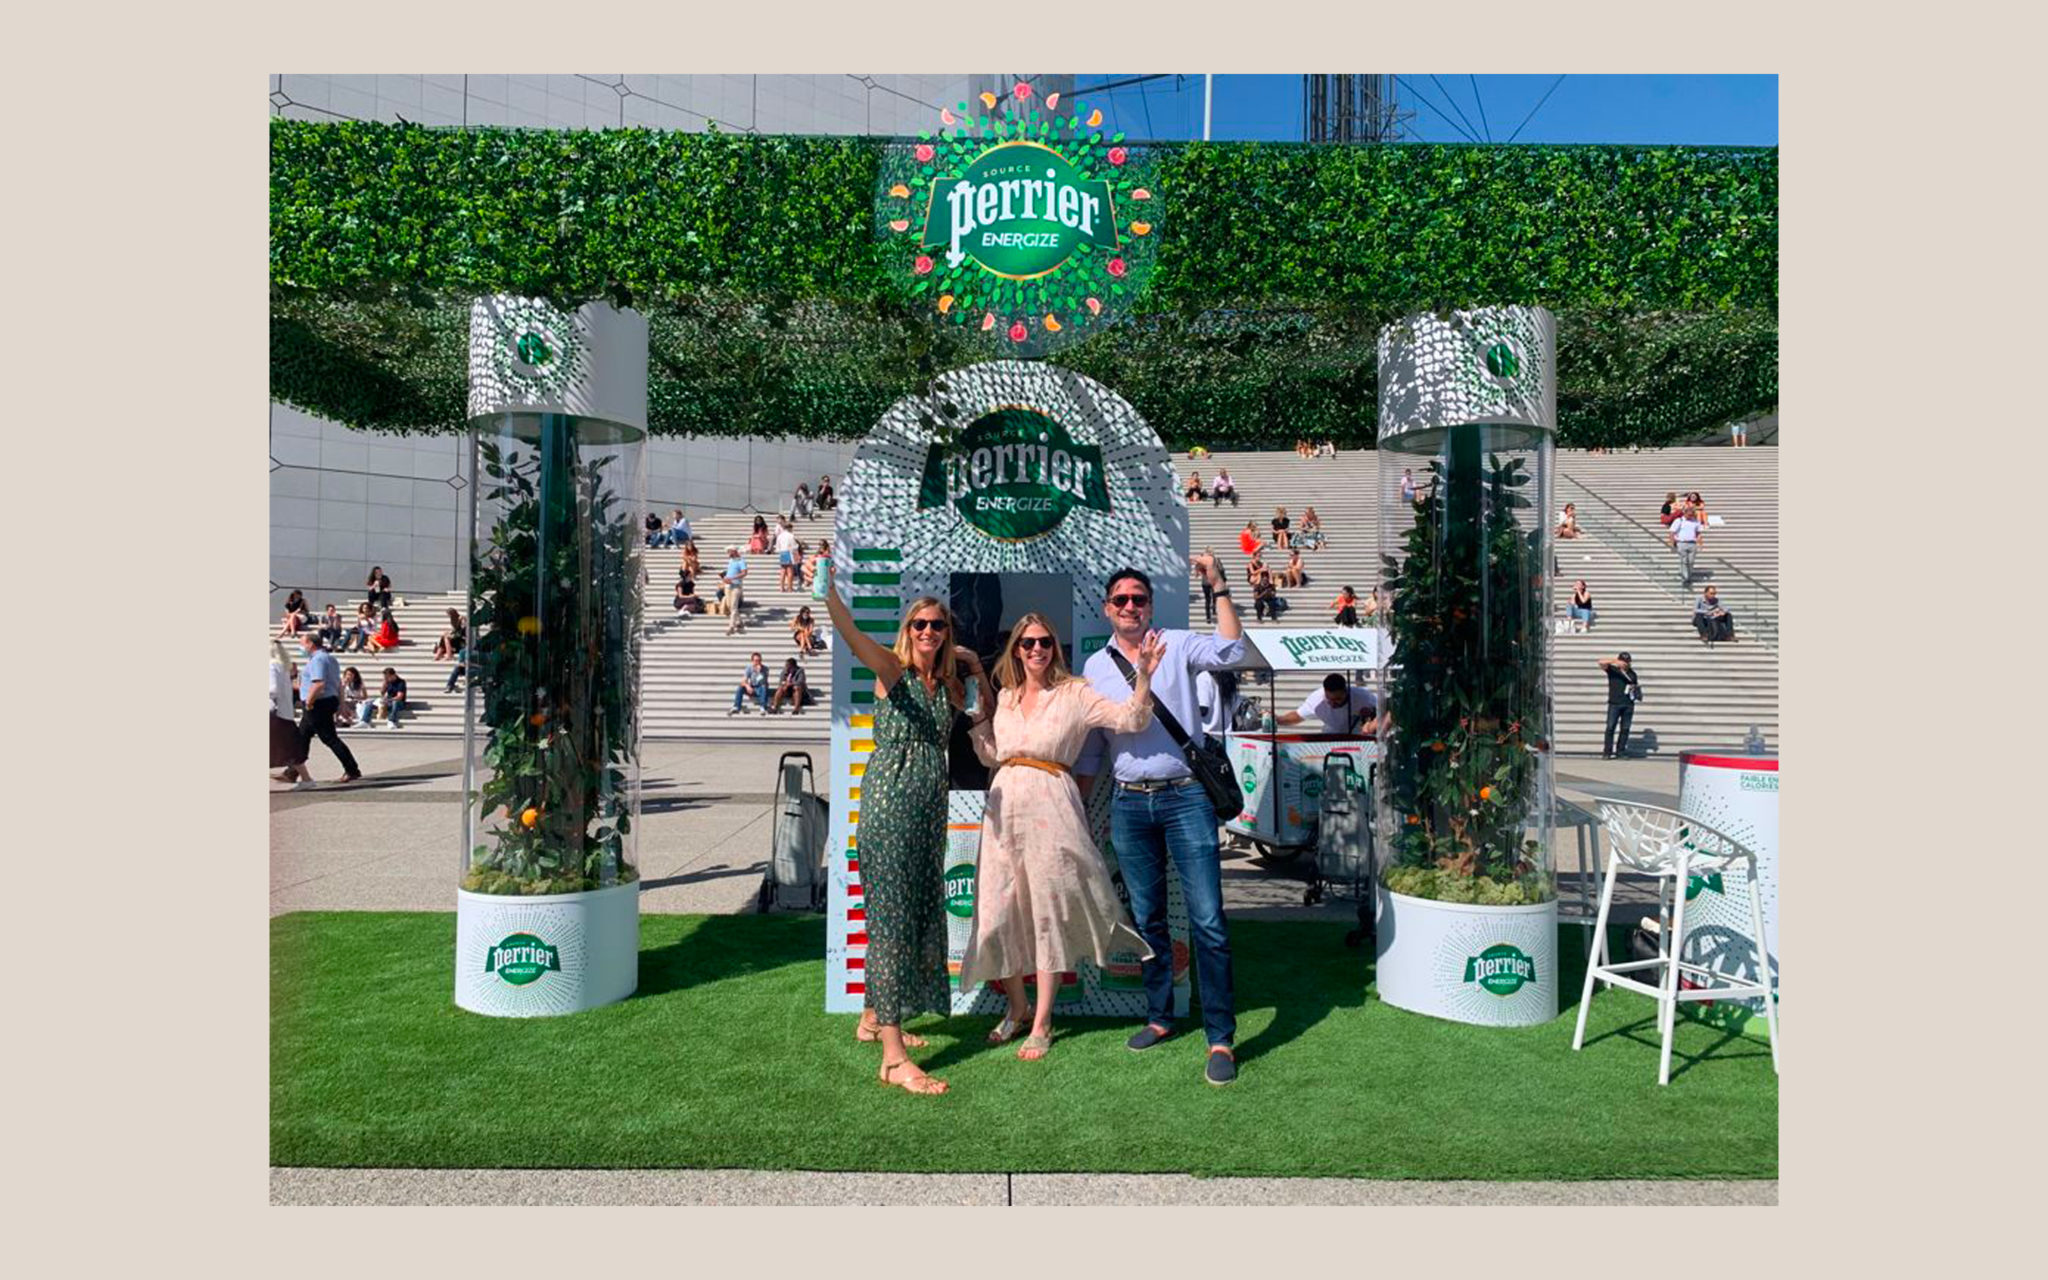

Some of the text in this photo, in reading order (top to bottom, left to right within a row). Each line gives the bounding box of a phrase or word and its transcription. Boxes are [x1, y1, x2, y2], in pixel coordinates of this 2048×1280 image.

[982, 165, 1031, 178] SOURCE
[981, 232, 1060, 250] ENERGIZE
[975, 496, 1053, 513] ENERGIZE
[1308, 655, 1368, 664] ENERGIZE
